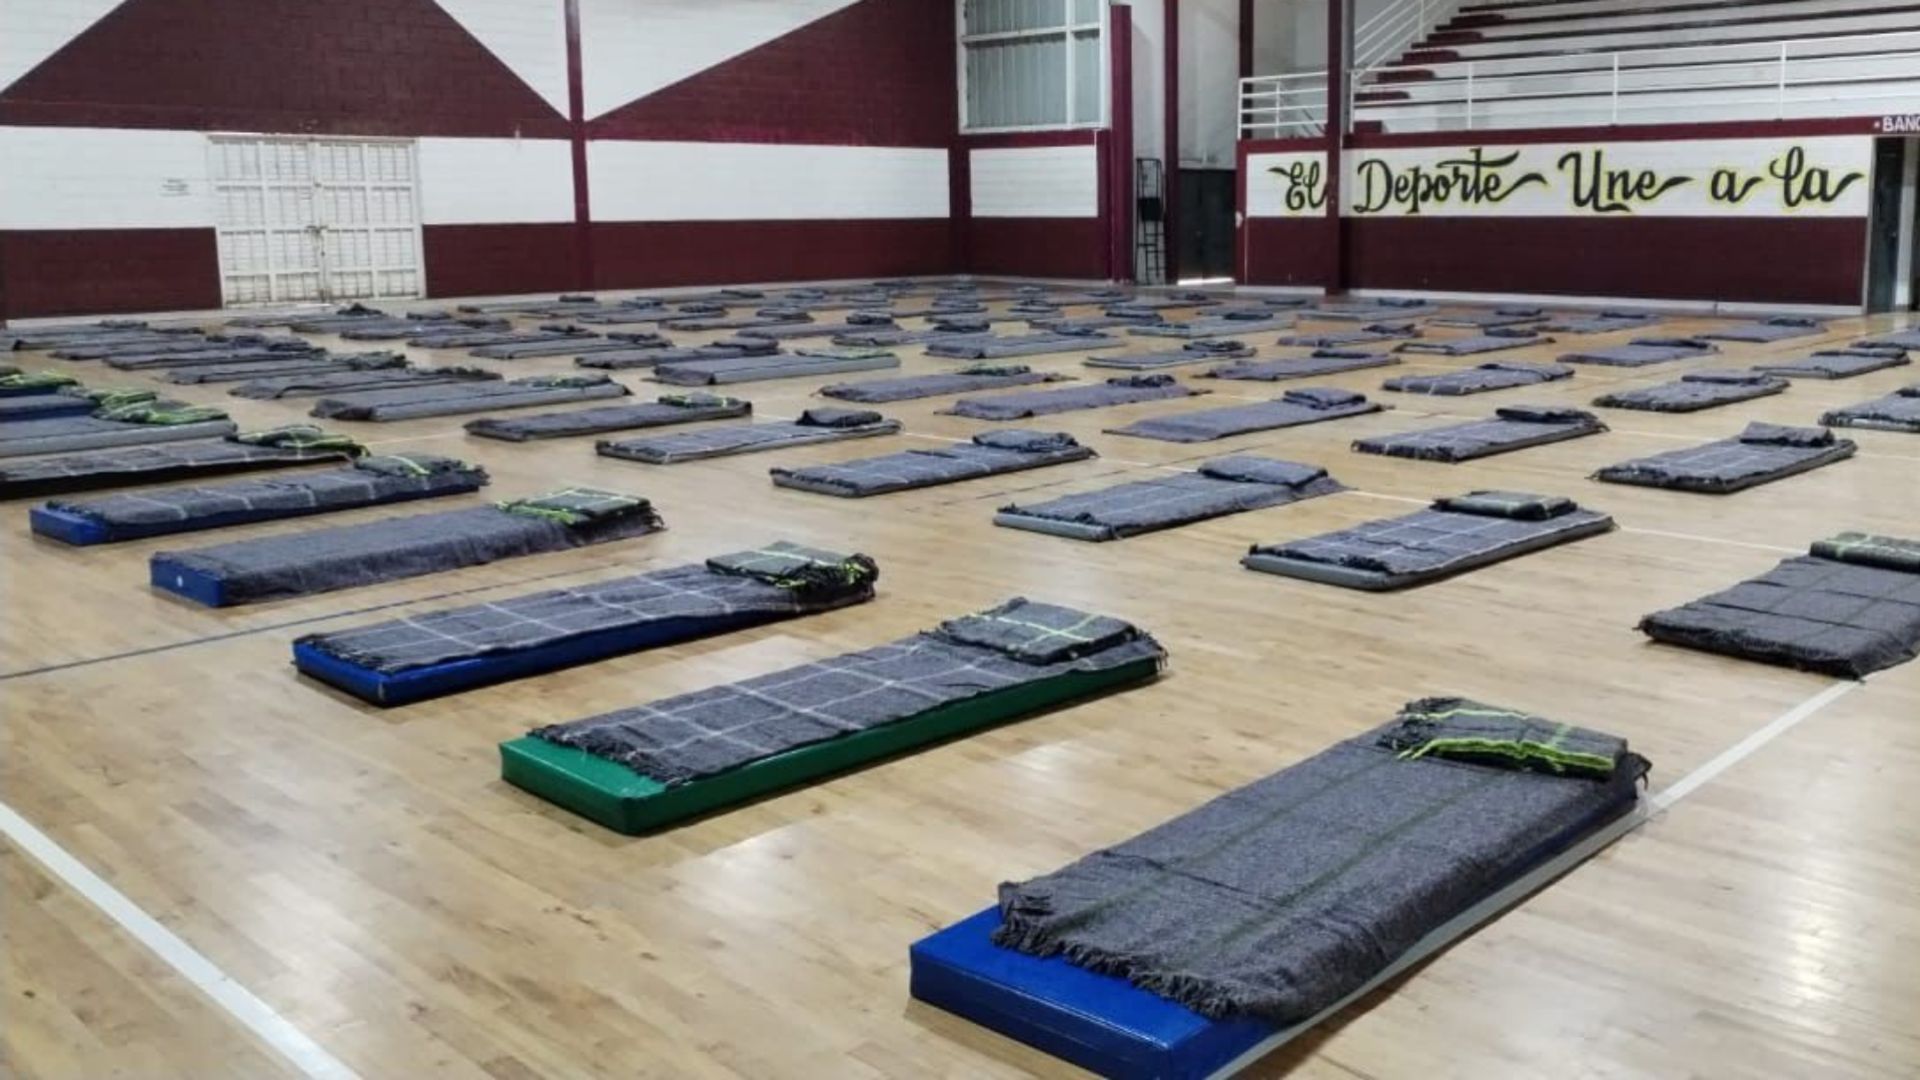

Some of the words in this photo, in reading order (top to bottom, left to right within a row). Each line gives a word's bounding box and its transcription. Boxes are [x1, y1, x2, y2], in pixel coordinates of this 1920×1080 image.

[1268, 160, 1327, 211] El
[1352, 147, 1548, 214] Deporte
[1557, 150, 1694, 212] Une
[1710, 169, 1764, 203] a
[1769, 146, 1864, 208] la
